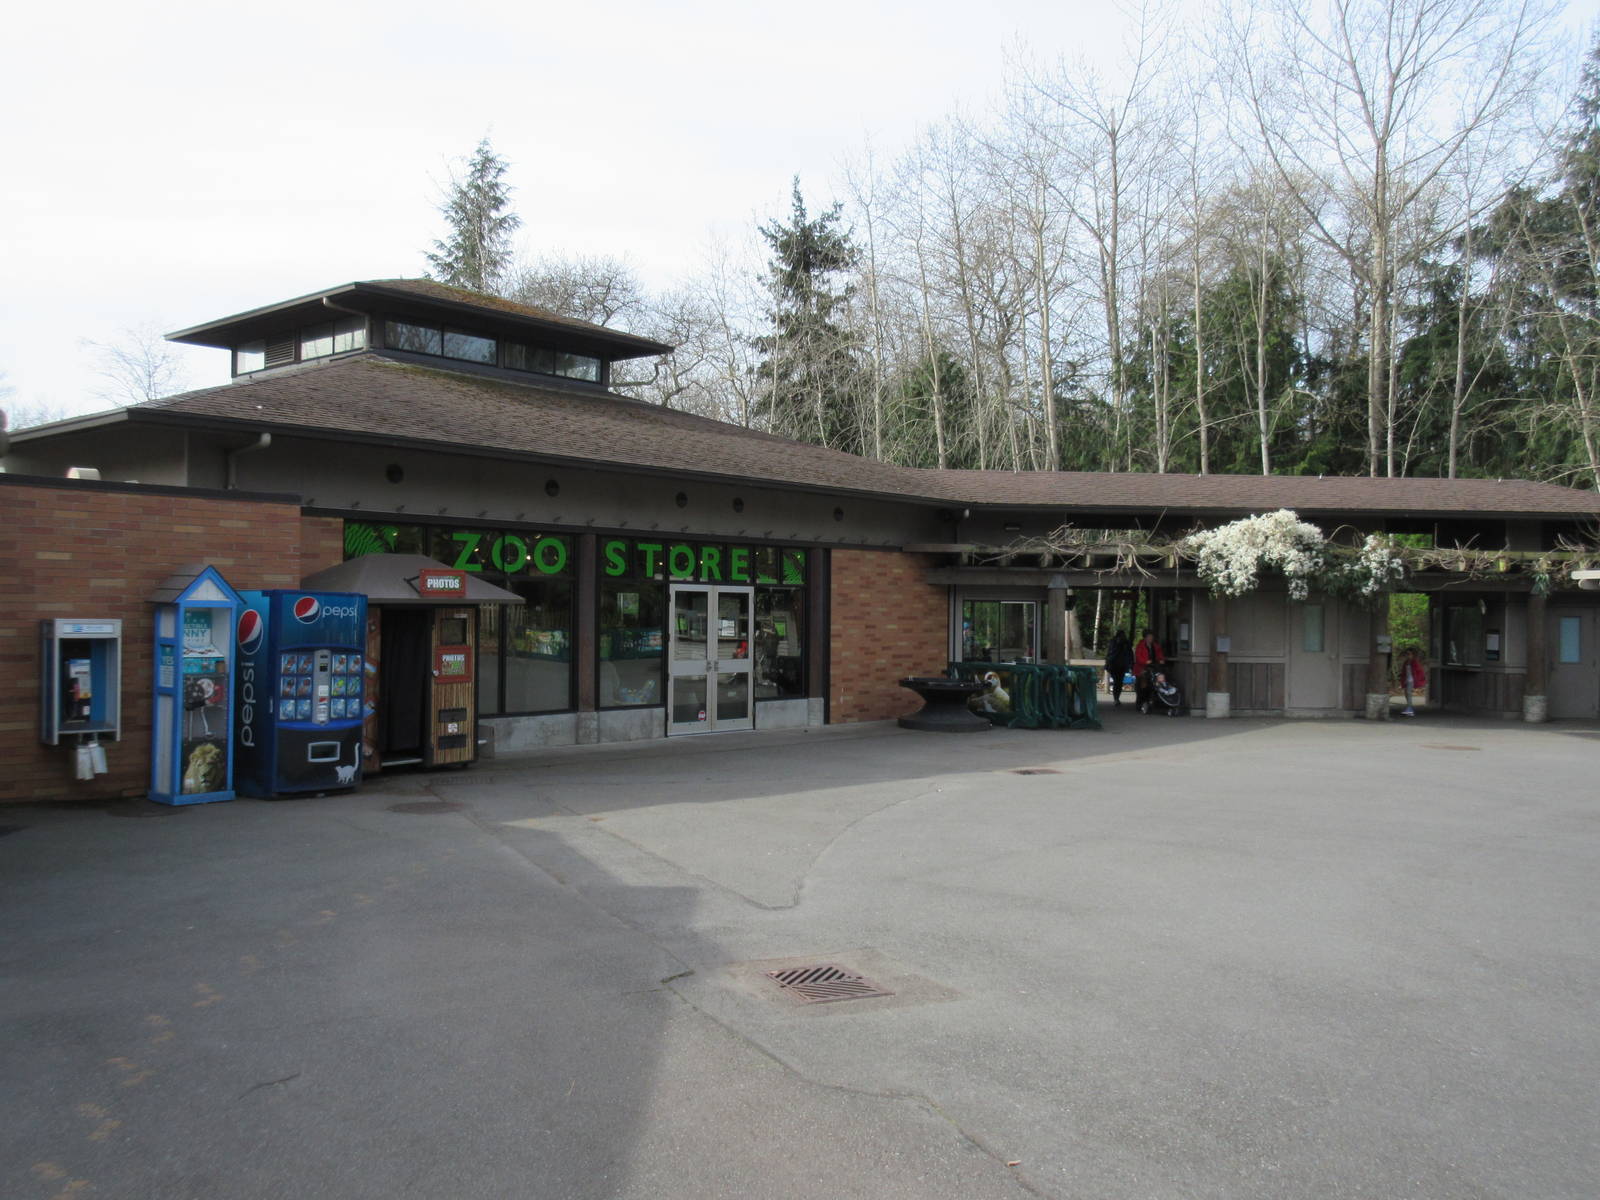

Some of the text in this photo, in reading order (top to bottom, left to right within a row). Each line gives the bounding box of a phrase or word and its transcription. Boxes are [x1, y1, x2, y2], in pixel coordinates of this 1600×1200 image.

[452, 532, 750, 581] ZOO STORE
[427, 578, 460, 588] PHOTOS
[322, 605, 357, 619] pepsi
[184, 629, 207, 637] NNY
[241, 662, 257, 747] pepsi
